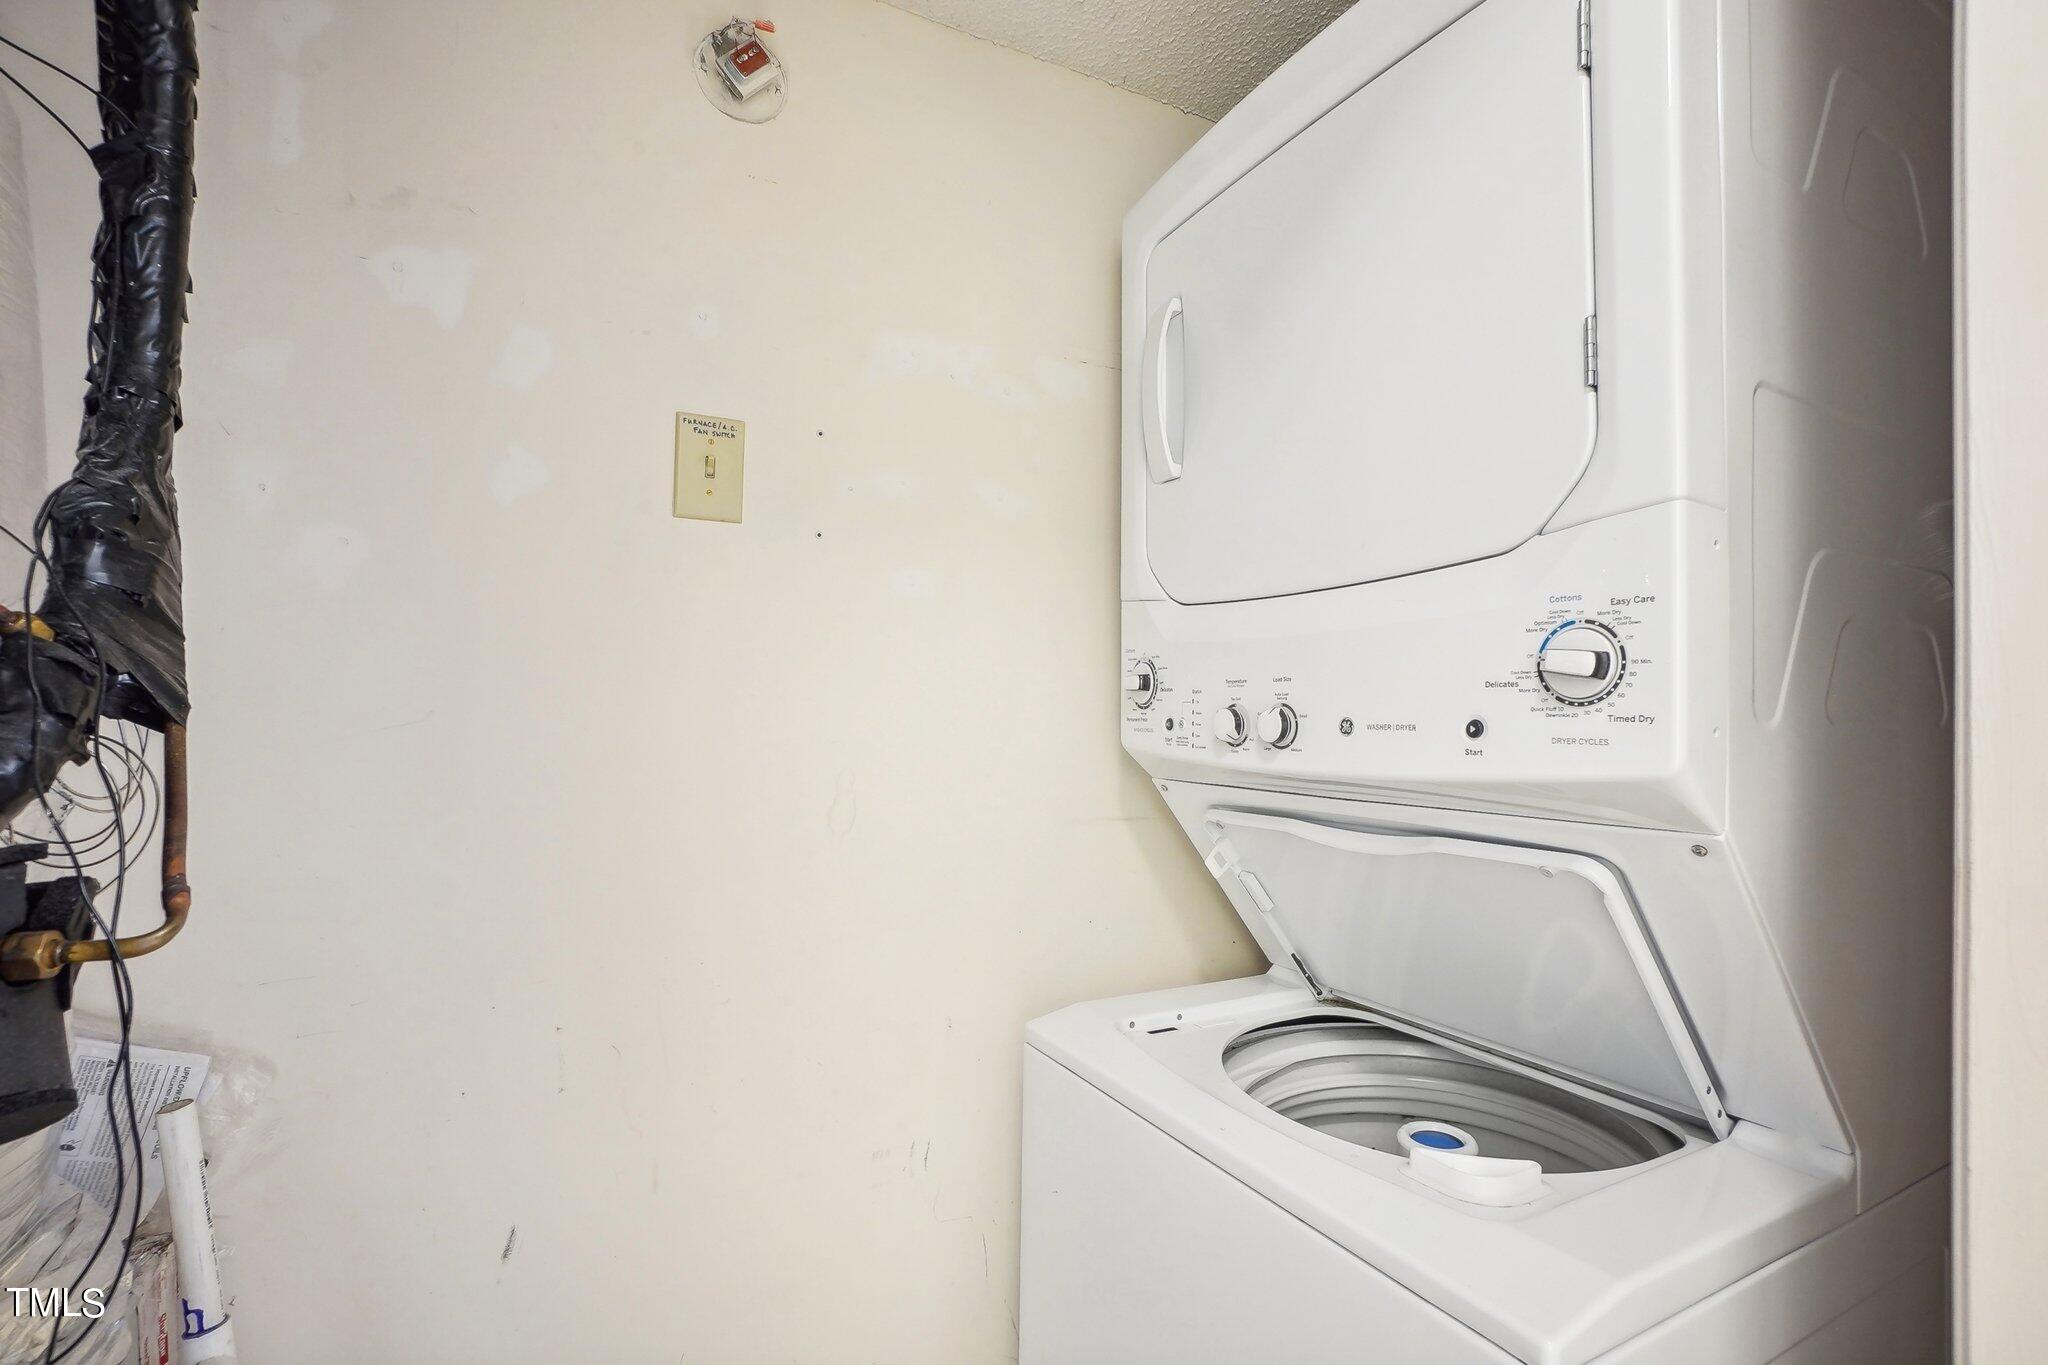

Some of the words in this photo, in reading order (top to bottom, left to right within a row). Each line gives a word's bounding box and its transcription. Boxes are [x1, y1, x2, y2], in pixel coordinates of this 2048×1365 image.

[693, 426, 708, 436] FAN
[712, 430, 736, 439] SWITCH
[1549, 593, 1582, 604] Cottons
[1610, 597, 1631, 606] Easy
[1633, 595, 1656, 604] Care
[1608, 714, 1636, 723] Timed
[1638, 714, 1655, 724] Dry
[1366, 723, 1392, 731] WASHER
[1395, 723, 1417, 732] DRYER
[1552, 737, 1577, 745] DRYER
[1578, 738, 1609, 746] CYCLES
[1464, 748, 1483, 756] Start
